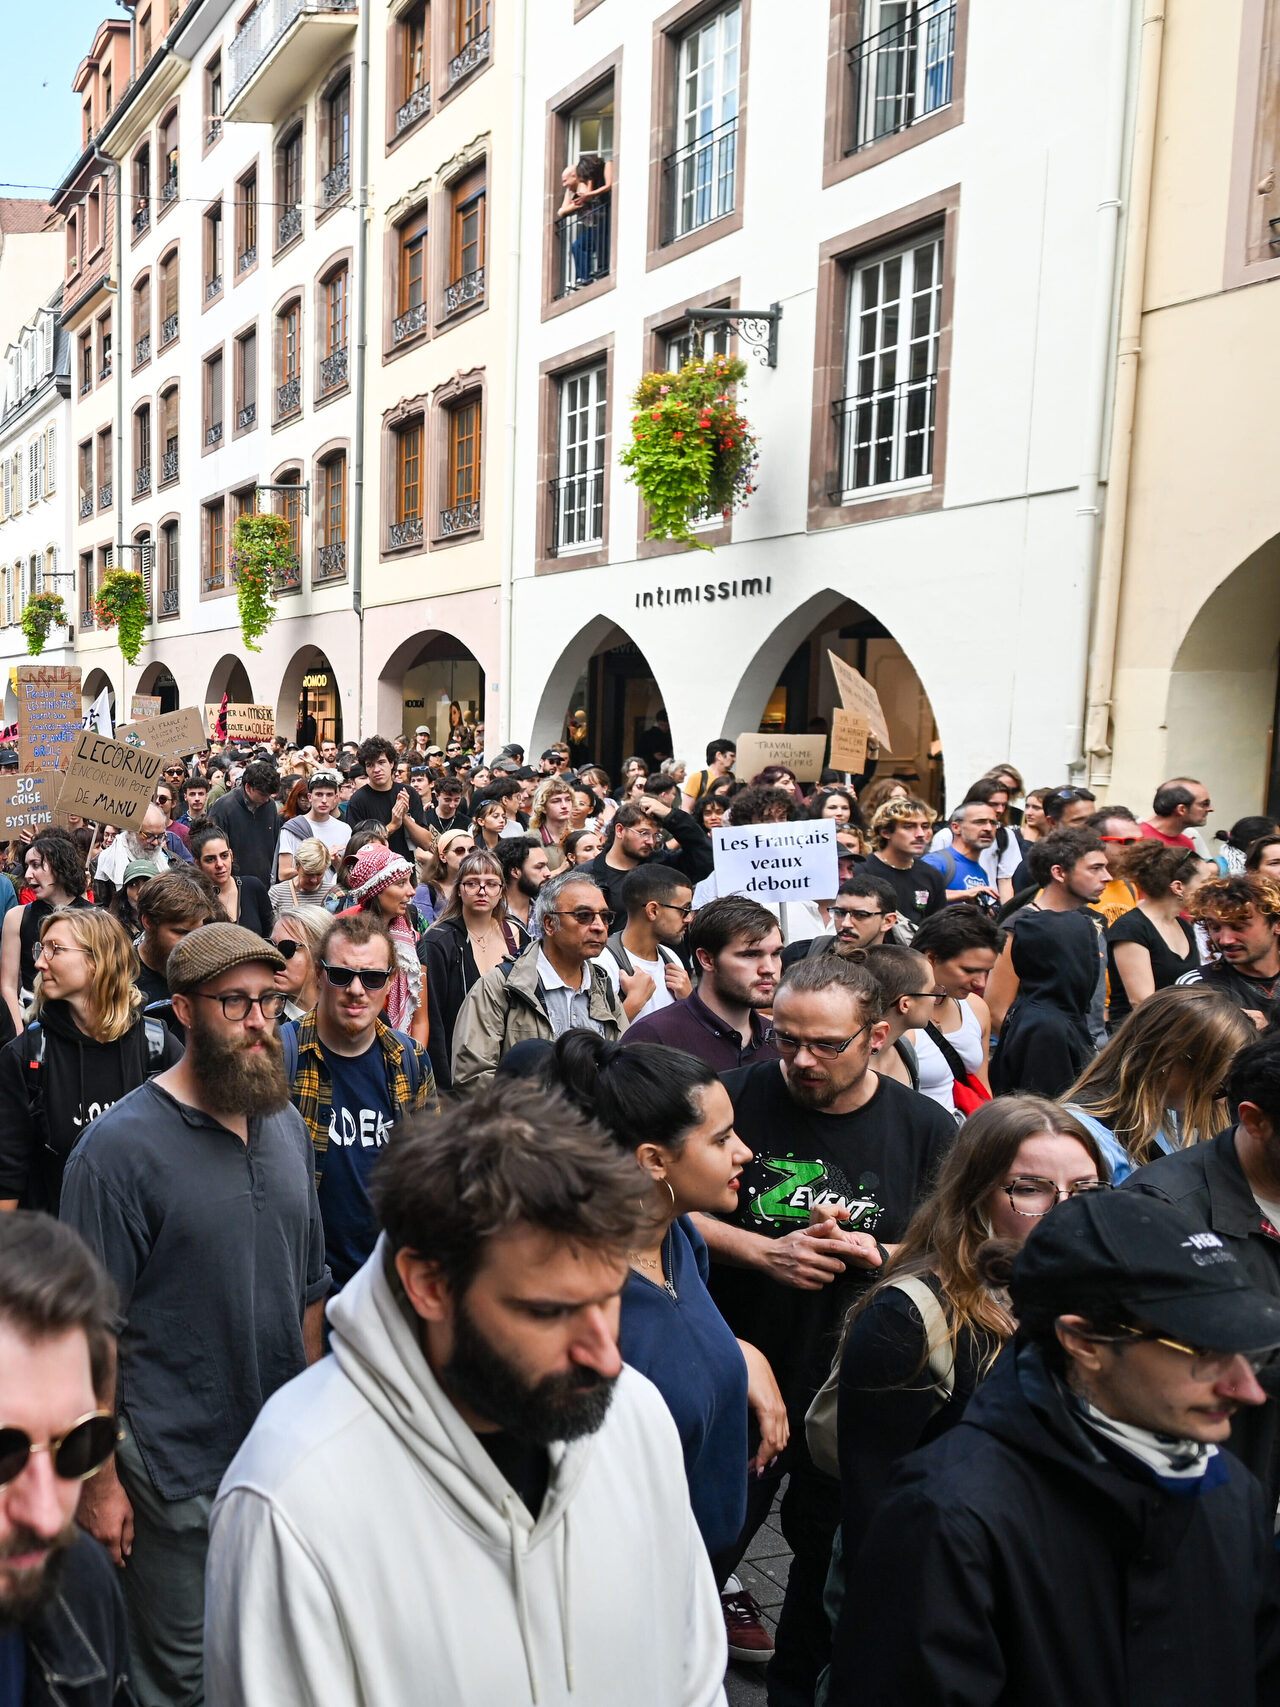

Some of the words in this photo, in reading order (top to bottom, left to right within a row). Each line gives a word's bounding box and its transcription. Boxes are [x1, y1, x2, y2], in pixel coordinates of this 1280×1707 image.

[635, 575, 772, 608] intimissimi
[303, 674, 327, 688] ROMOD
[754, 740, 792, 750] TRAVAIL
[77, 737, 160, 779] LECORNU
[16, 777, 34, 794] 50
[71, 762, 113, 786] ENCORE
[114, 775, 128, 788] UN
[128, 780, 151, 796] POTE
[11, 791, 41, 806] CRISE
[74, 787, 89, 804] DE
[93, 793, 137, 818] MANU
[720, 838, 749, 851] Les
[755, 830, 830, 849] Français
[750, 856, 803, 870] veaux
[746, 876, 811, 892] debout
